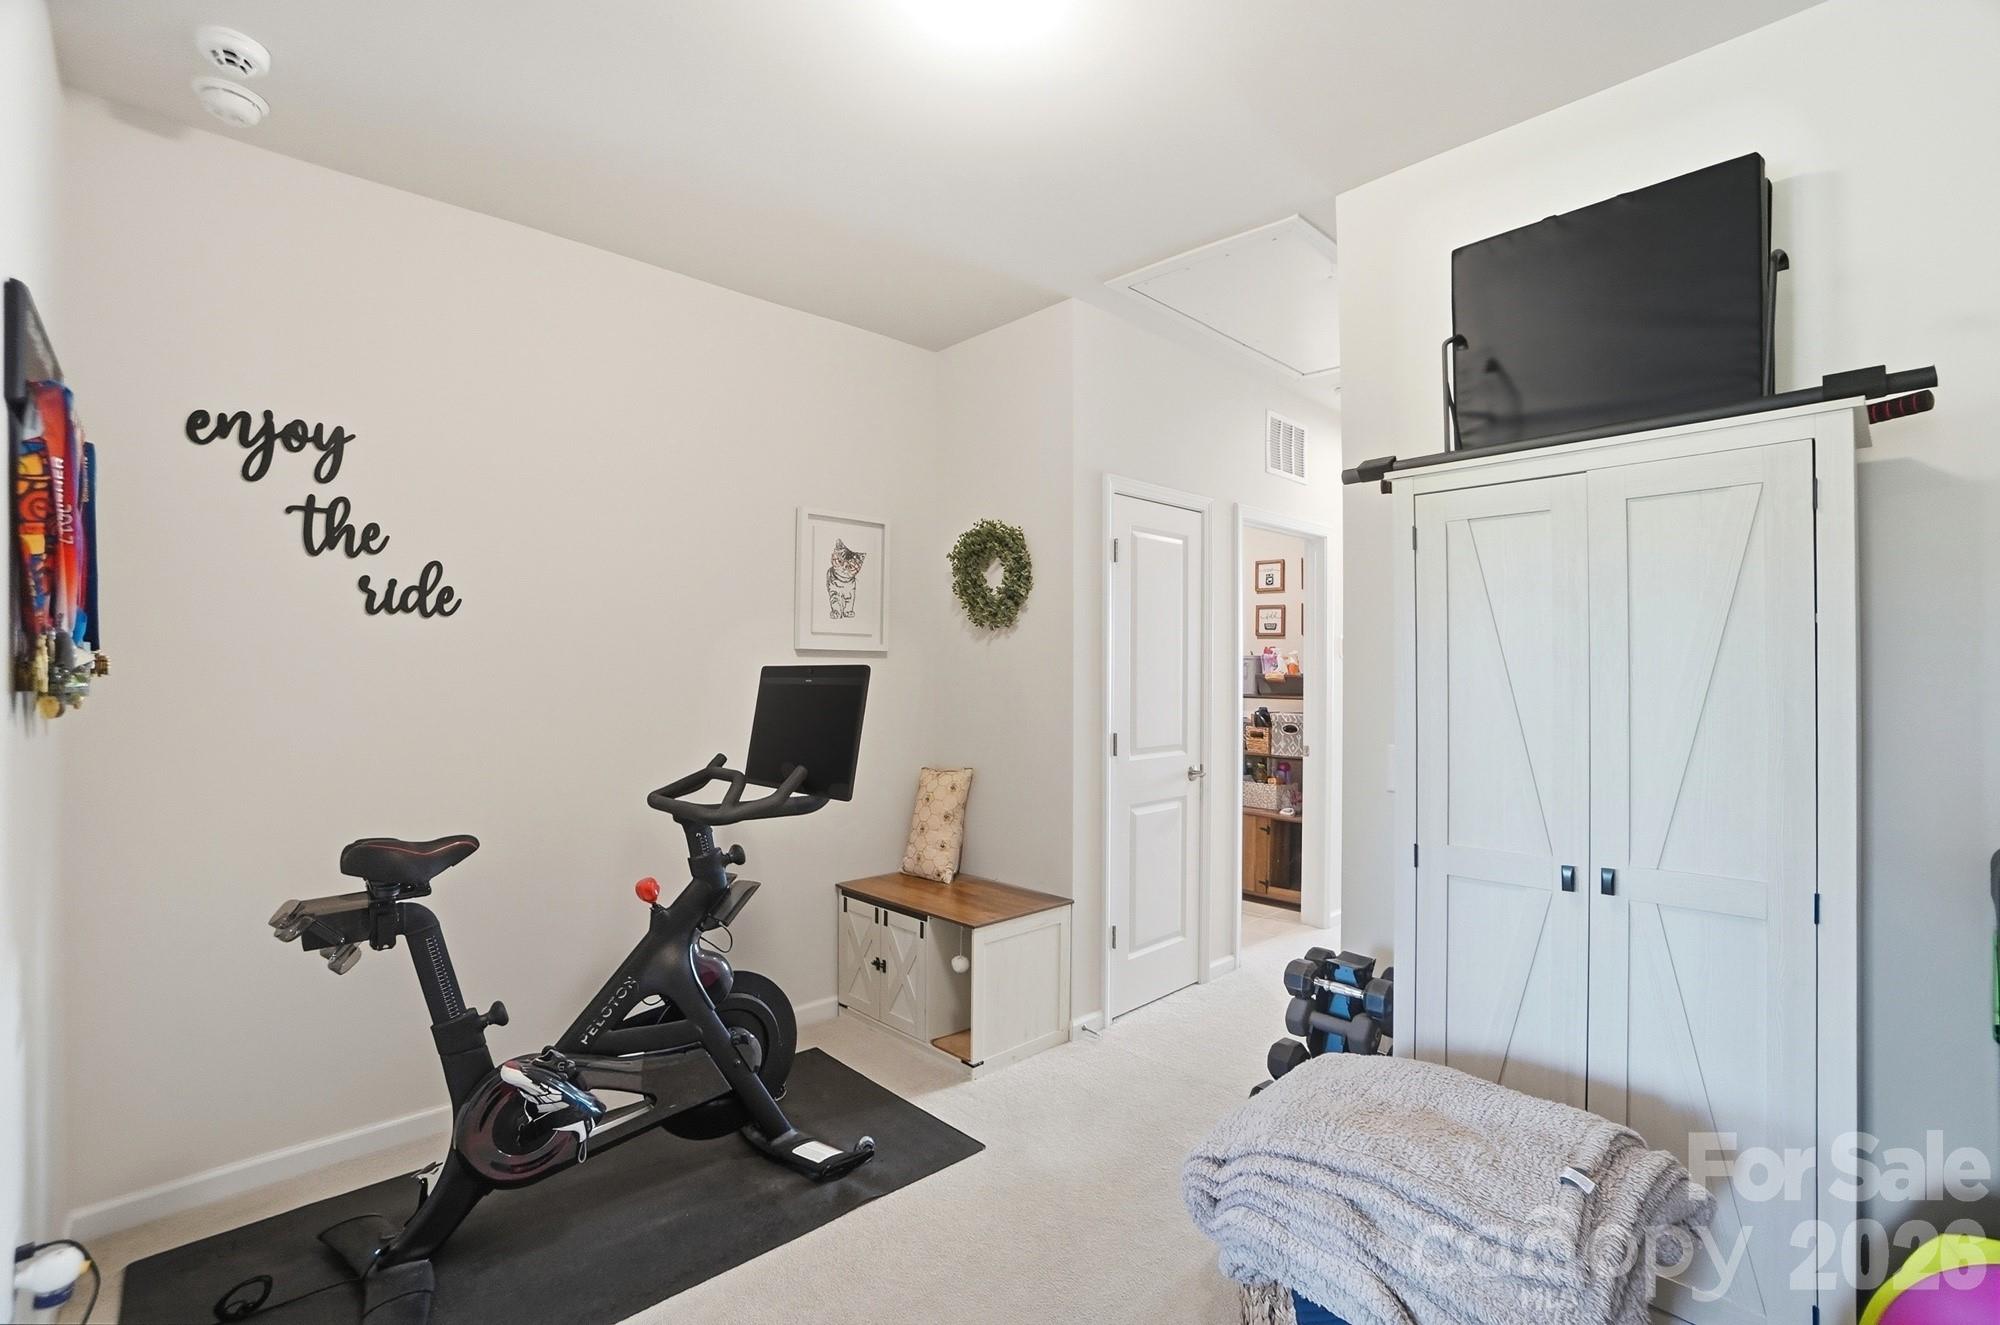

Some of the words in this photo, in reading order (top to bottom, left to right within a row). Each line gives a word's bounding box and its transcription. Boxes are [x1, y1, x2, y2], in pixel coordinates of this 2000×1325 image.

[186, 409, 356, 484] enjoy
[285, 494, 391, 559] the
[358, 560, 462, 618] ride
[581, 975, 640, 1045] PELOTON
